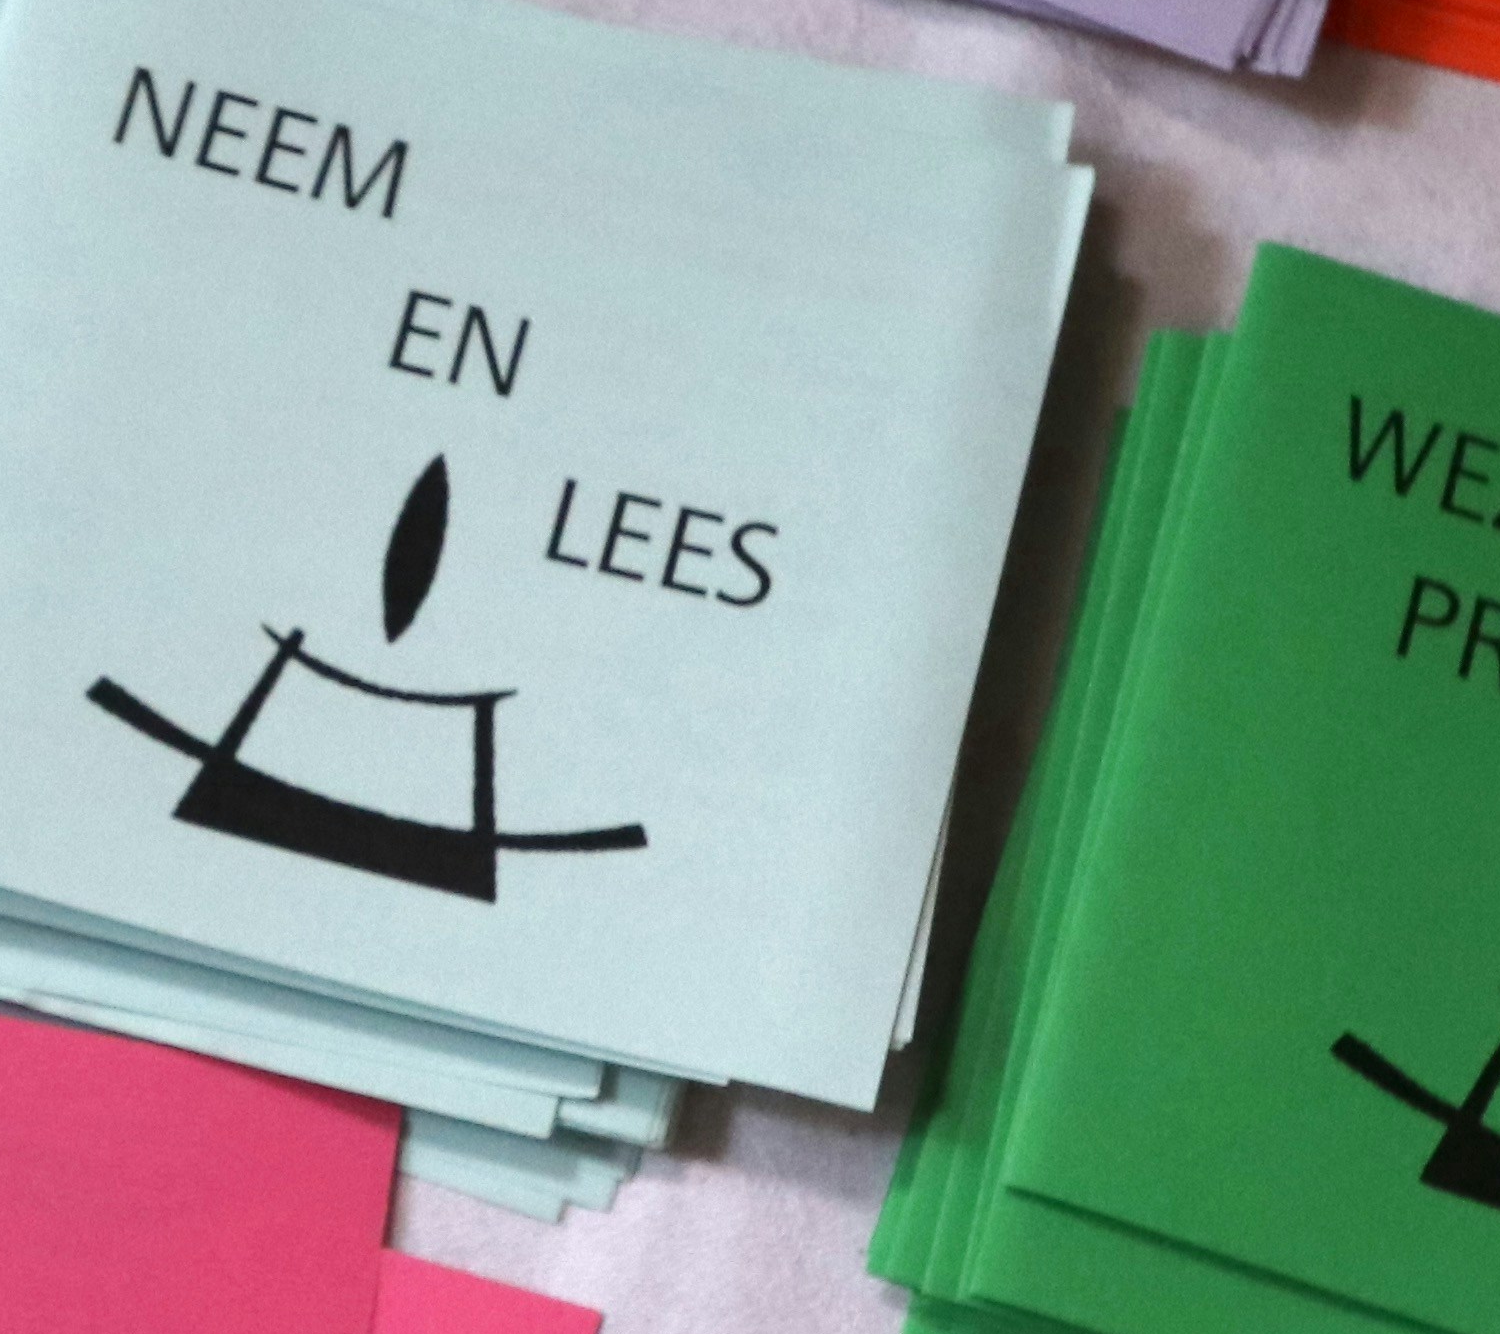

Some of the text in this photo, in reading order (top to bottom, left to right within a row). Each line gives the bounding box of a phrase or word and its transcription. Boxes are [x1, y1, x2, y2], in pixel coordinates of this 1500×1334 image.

[114, 67, 408, 219] NEEM
[389, 290, 530, 397] EN
[546, 479, 777, 607] LEES
